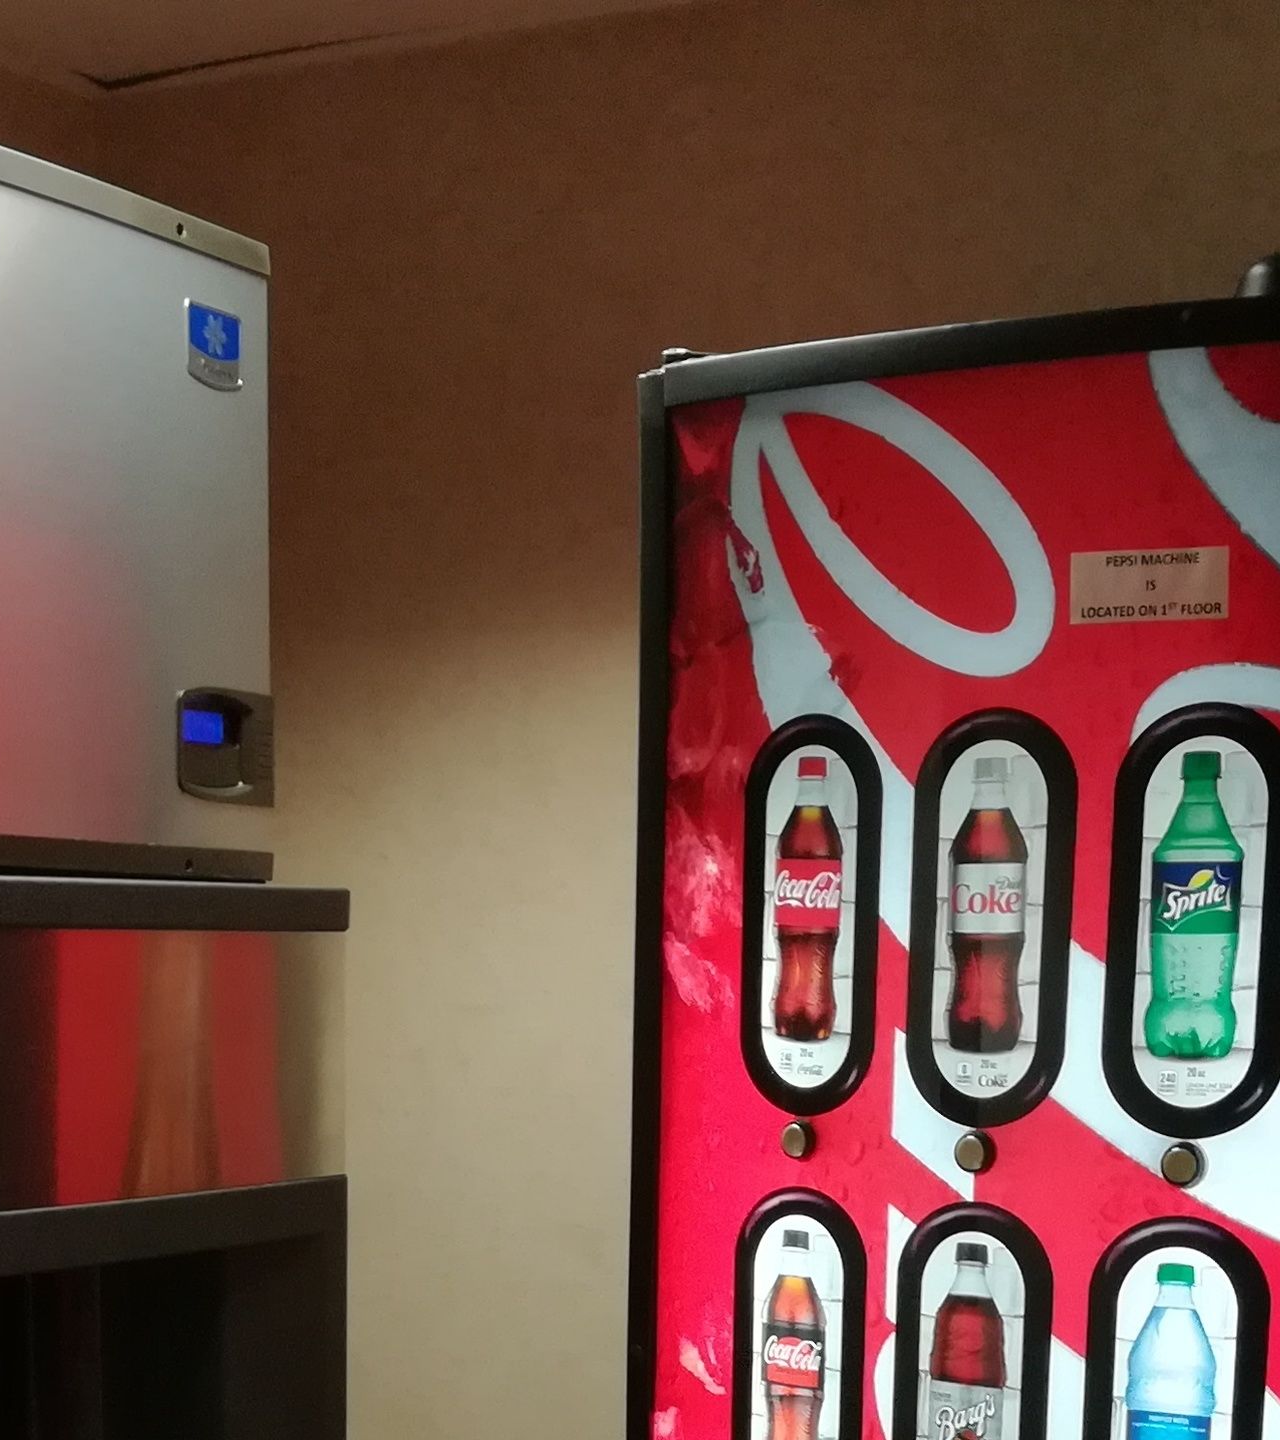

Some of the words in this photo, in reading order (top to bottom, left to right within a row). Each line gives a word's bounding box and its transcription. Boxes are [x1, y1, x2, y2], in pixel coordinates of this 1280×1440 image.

[1106, 554, 1138, 567] PEPSI
[1141, 552, 1200, 566] MACHINE
[1145, 580, 1156, 591] IS
[1081, 606, 1135, 618] LOCATED
[1138, 605, 1157, 616] ON
[1181, 602, 1222, 615] FLOOR
[774, 870, 841, 909] Coca-Cola
[951, 883, 1023, 914] Coke
[1163, 879, 1226, 920] Sprite
[1160, 1073, 1176, 1083] 240
[1187, 1067, 1197, 1077] 20
[978, 1074, 1009, 1087] Coke
[764, 1335, 822, 1371] Coca-Cola
